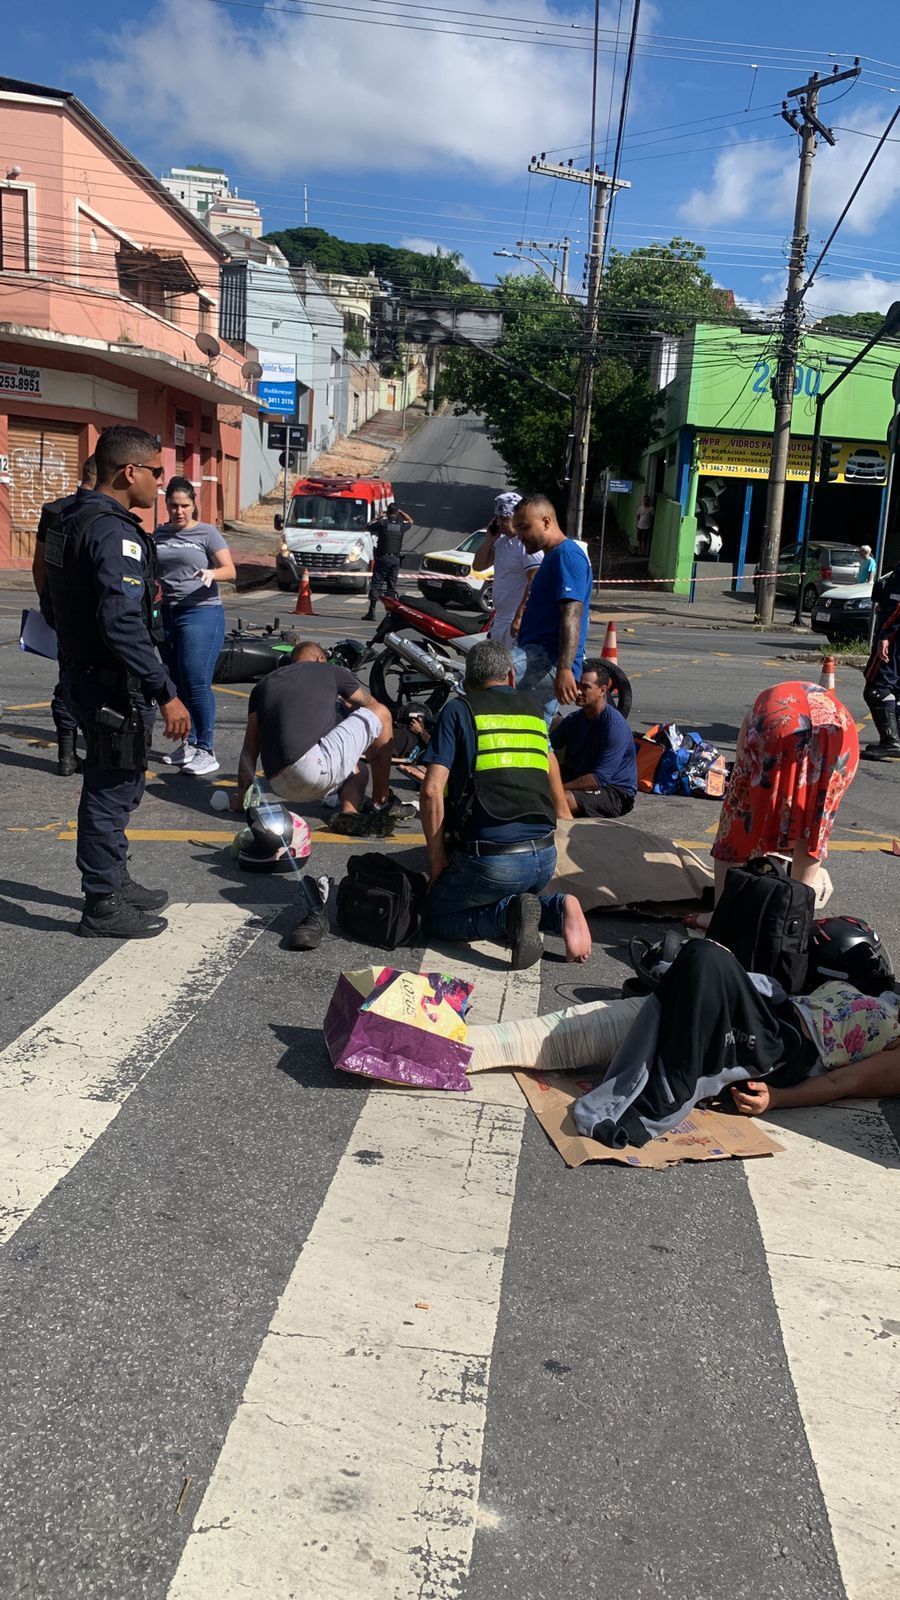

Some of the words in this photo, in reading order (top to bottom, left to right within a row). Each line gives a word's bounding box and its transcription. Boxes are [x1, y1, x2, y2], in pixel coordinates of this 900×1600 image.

[18, 367, 41, 379] Aluga
[278, 365, 294, 374] Santo
[730, 439, 761, 449] VIDROS
[762, 442, 773, 450] PA
[402, 977, 417, 1018] LOTUS
